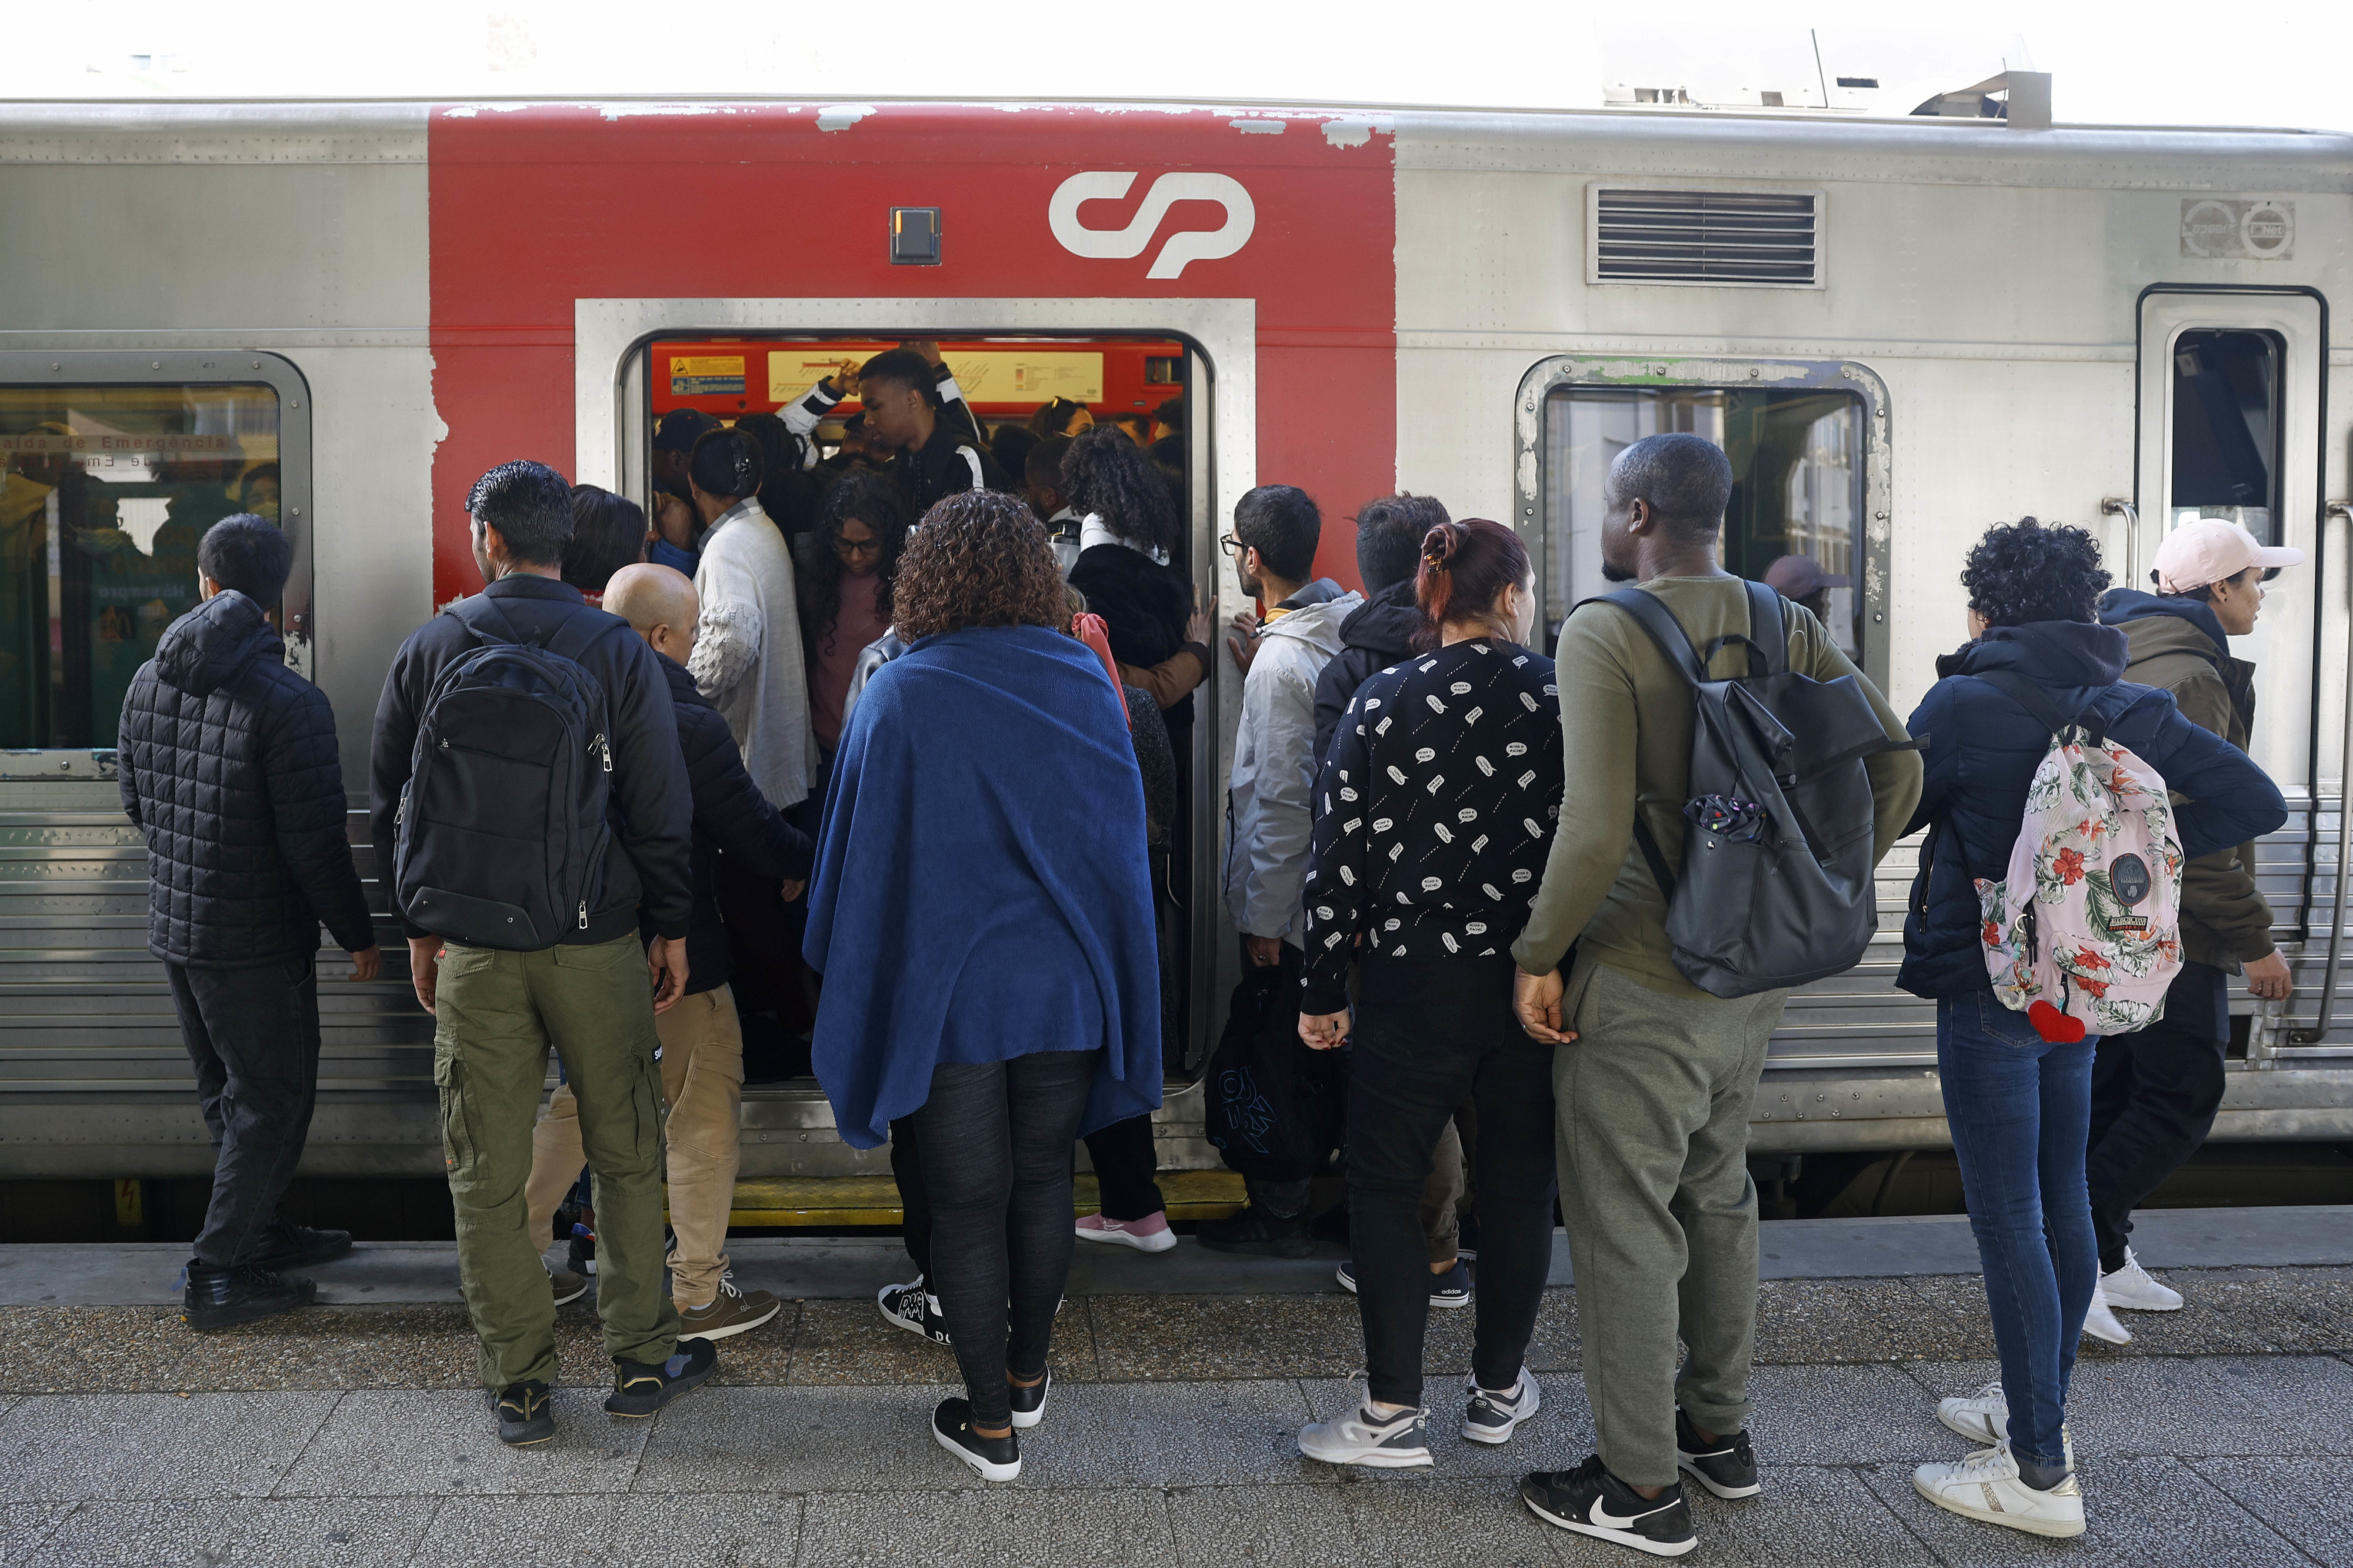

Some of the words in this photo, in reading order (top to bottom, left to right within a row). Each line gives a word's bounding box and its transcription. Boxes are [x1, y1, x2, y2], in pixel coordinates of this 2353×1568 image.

[1048, 171, 1255, 279] CP
[4, 436, 46, 449] aída
[63, 436, 85, 449] de
[102, 436, 225, 451] Emergência
[898, 1292, 924, 1321] D&G
